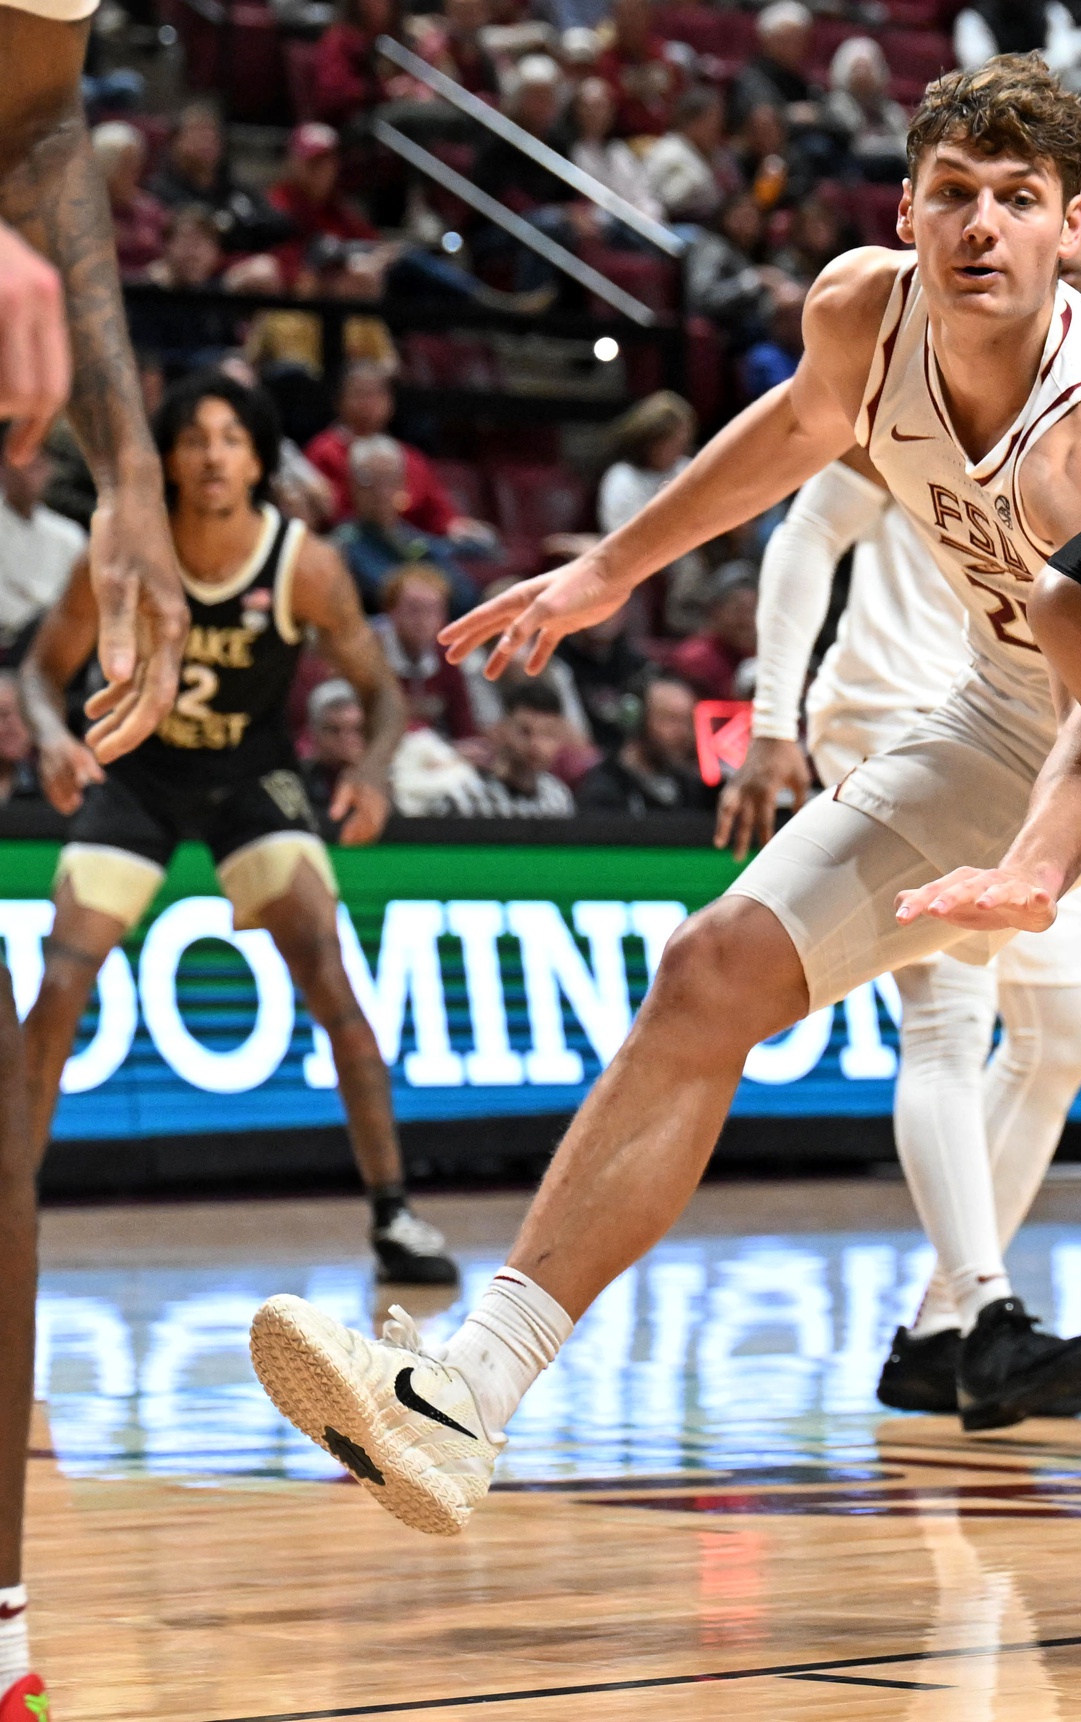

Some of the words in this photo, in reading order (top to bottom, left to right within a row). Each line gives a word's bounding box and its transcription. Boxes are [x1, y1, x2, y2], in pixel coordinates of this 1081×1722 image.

[927, 482, 1034, 582] FSU
[183, 624, 257, 669] AKE
[963, 571, 1043, 655] 2
[176, 663, 219, 720] 2
[0, 895, 903, 1095] DOMIN
